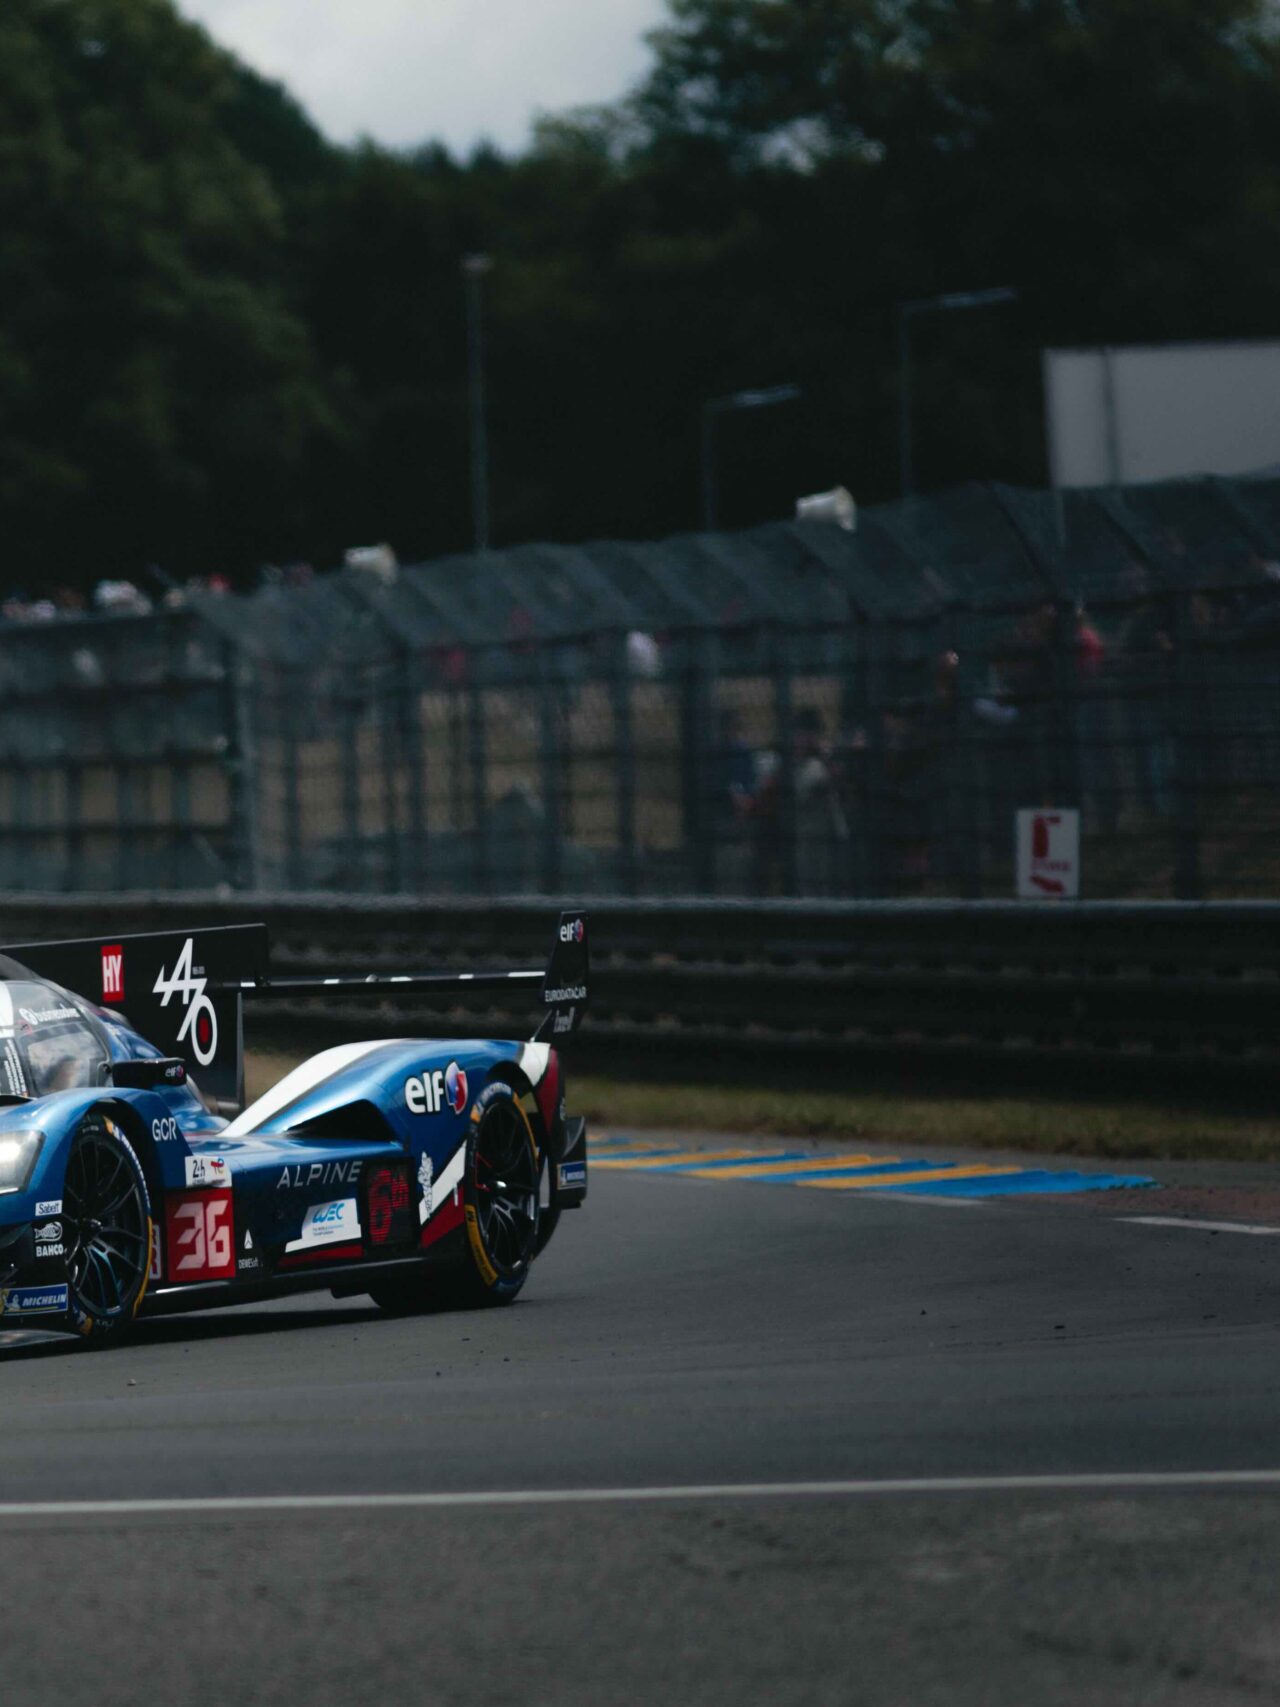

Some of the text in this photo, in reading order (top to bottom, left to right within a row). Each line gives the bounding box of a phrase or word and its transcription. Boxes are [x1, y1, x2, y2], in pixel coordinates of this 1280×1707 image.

[560, 923, 574, 941] elf
[103, 955, 121, 992] HY
[545, 986, 587, 1002] EURODATACAR
[405, 1071, 444, 1114] elf
[276, 1161, 363, 1189] ALPINE
[312, 1203, 345, 1224] WEC
[174, 1200, 231, 1271] 36
[36, 1244, 64, 1257] BAHCO
[22, 1294, 67, 1307] MICHELIN
